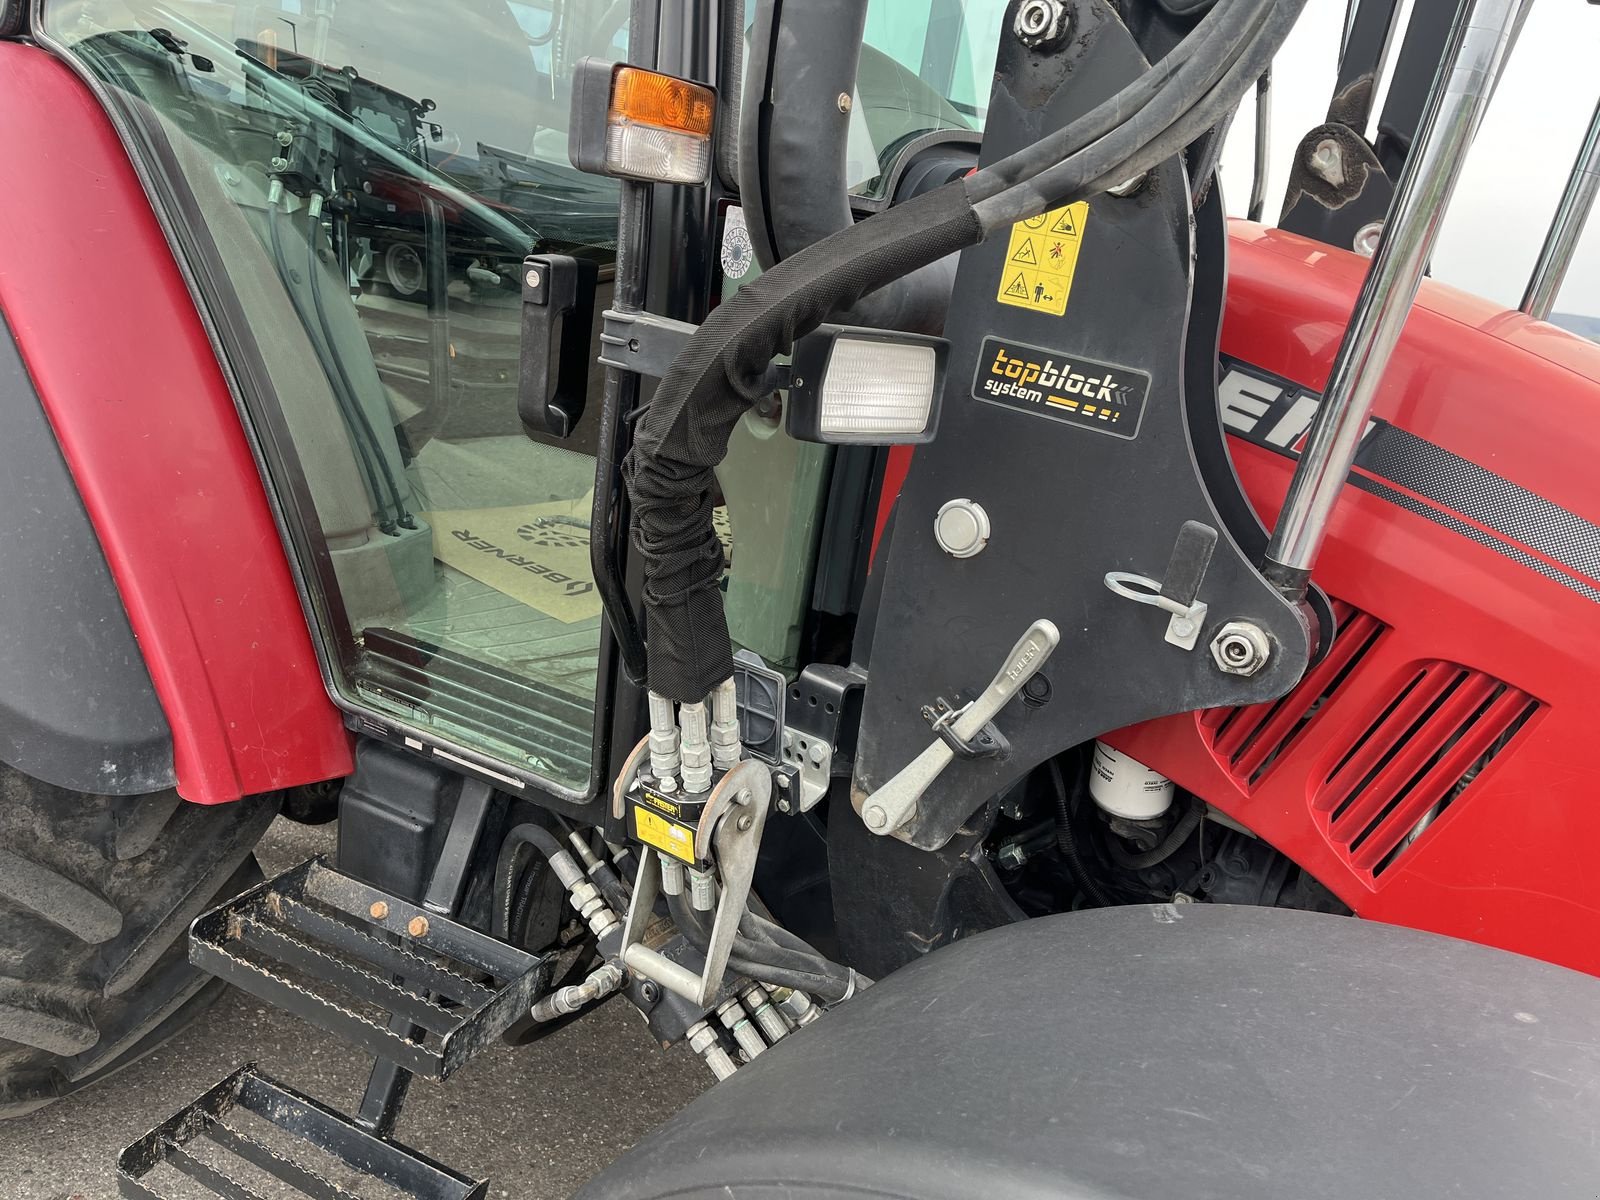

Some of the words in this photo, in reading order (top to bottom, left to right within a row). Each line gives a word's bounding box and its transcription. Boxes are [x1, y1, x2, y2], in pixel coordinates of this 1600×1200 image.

[984, 378, 1042, 403] system
[991, 349, 1118, 402] topblock
[451, 528, 571, 583] BERNER
